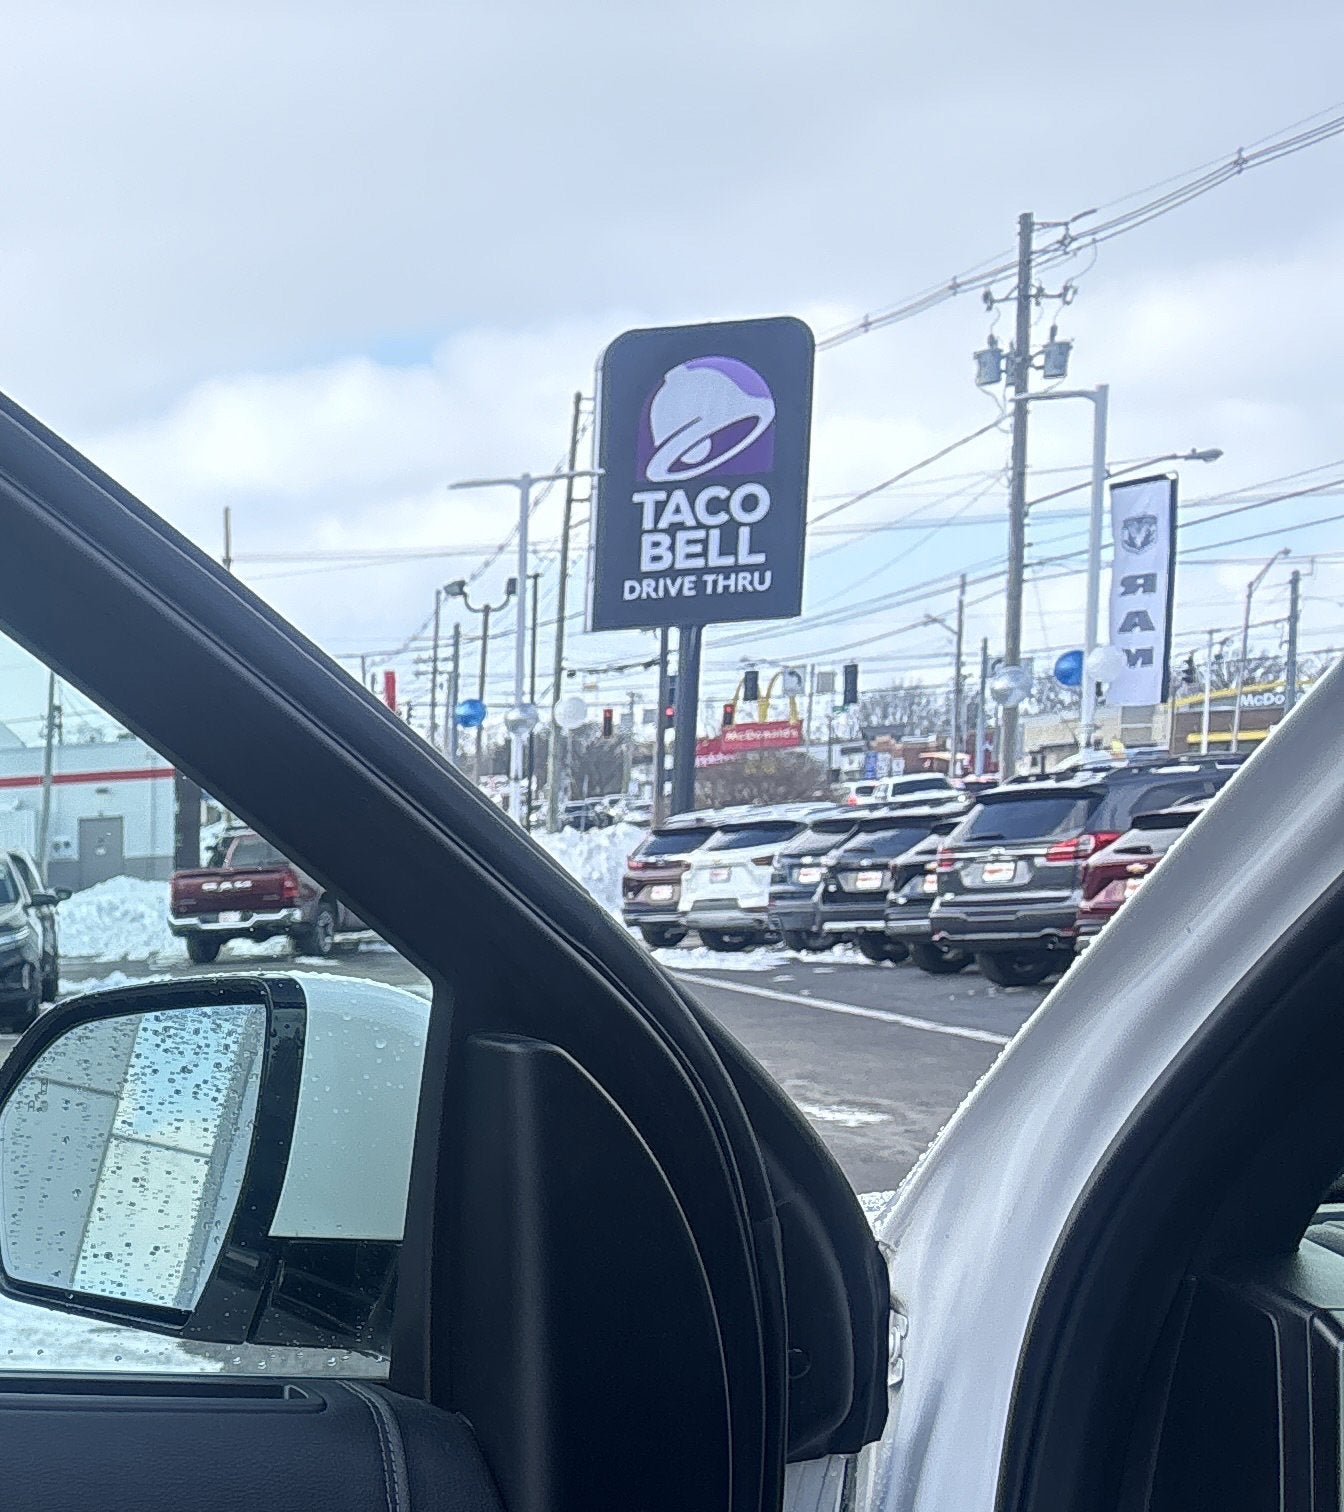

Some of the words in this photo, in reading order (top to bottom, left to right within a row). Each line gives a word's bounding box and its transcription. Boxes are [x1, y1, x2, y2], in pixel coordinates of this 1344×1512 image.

[632, 482, 771, 531] TACO
[640, 525, 766, 573] BELL
[623, 574, 698, 601] DRIVE
[701, 569, 772, 596] THRU
